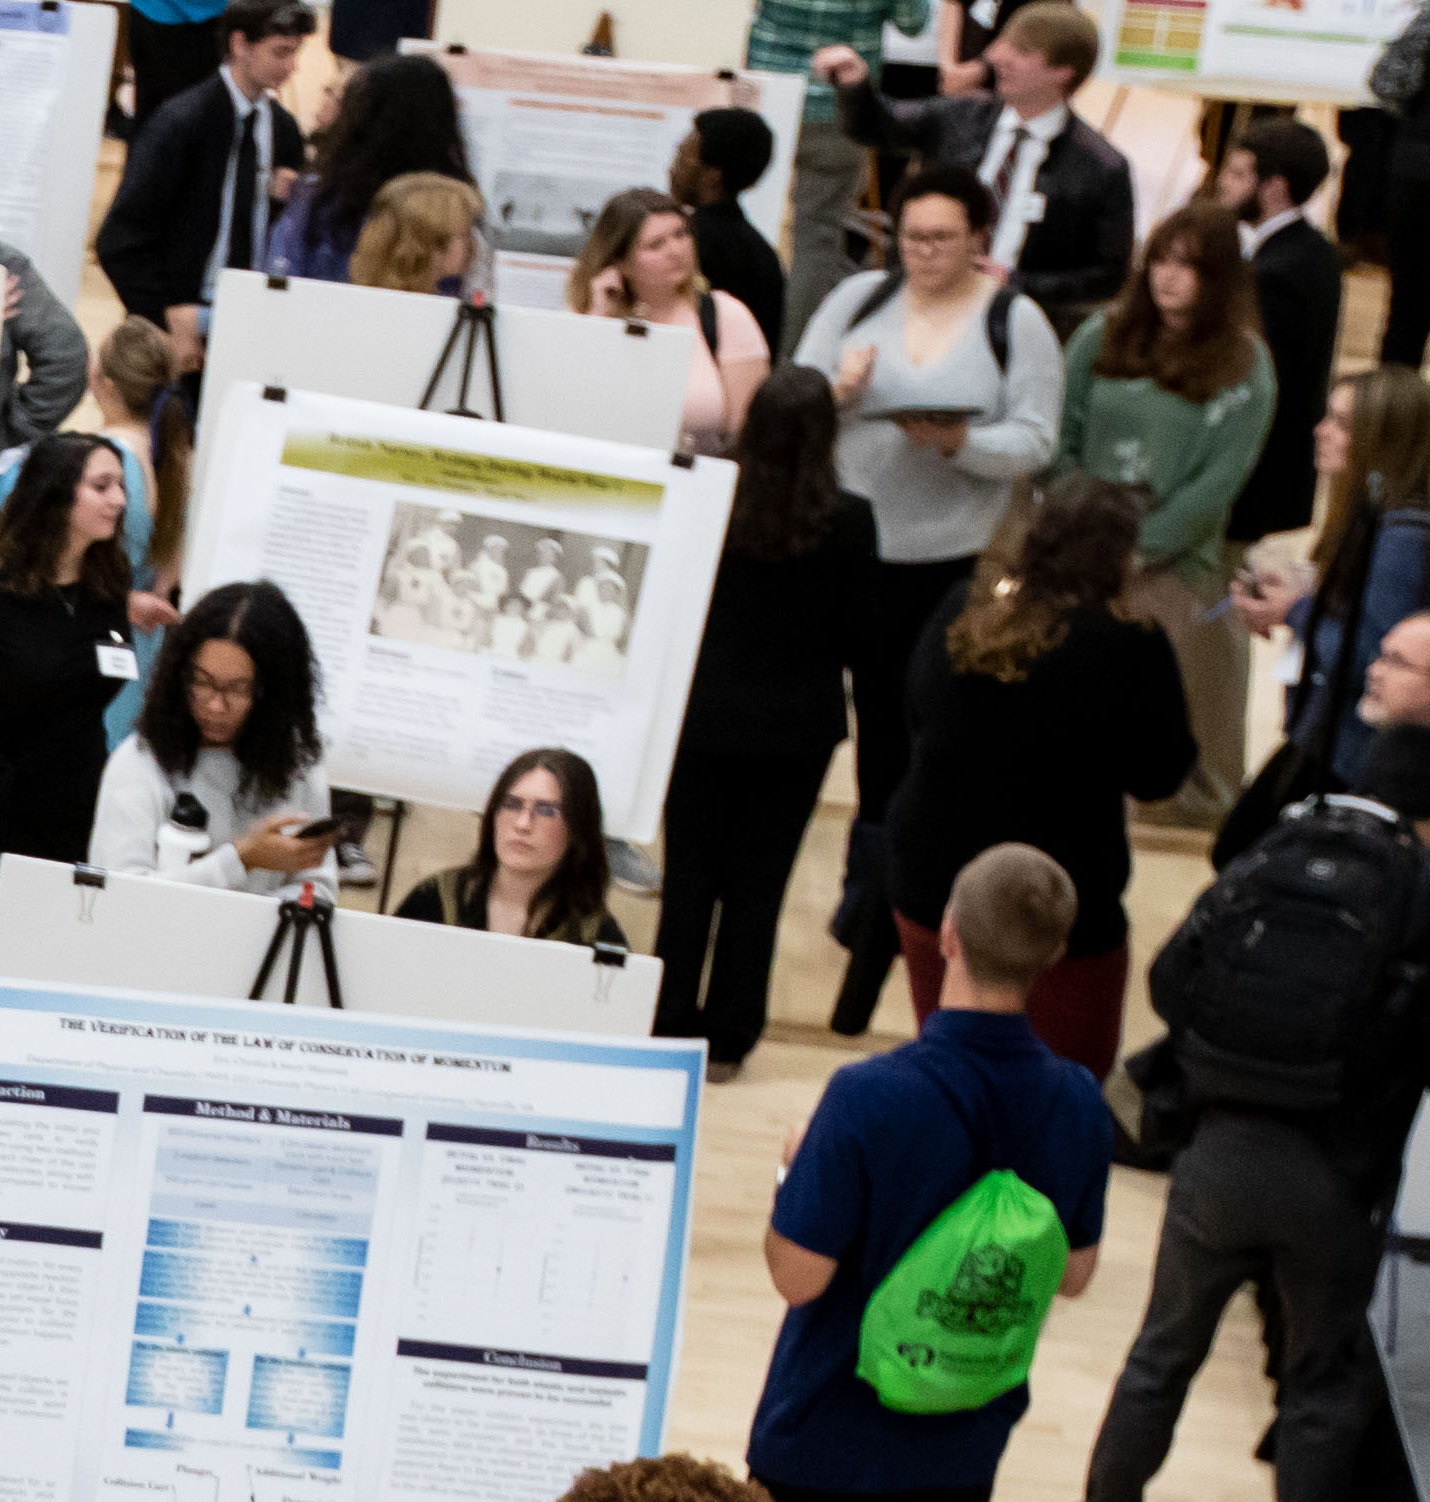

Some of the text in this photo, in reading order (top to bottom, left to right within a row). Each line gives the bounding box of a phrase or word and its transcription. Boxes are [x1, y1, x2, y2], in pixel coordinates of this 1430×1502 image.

[195, 1101, 350, 1129] Method & Materials
